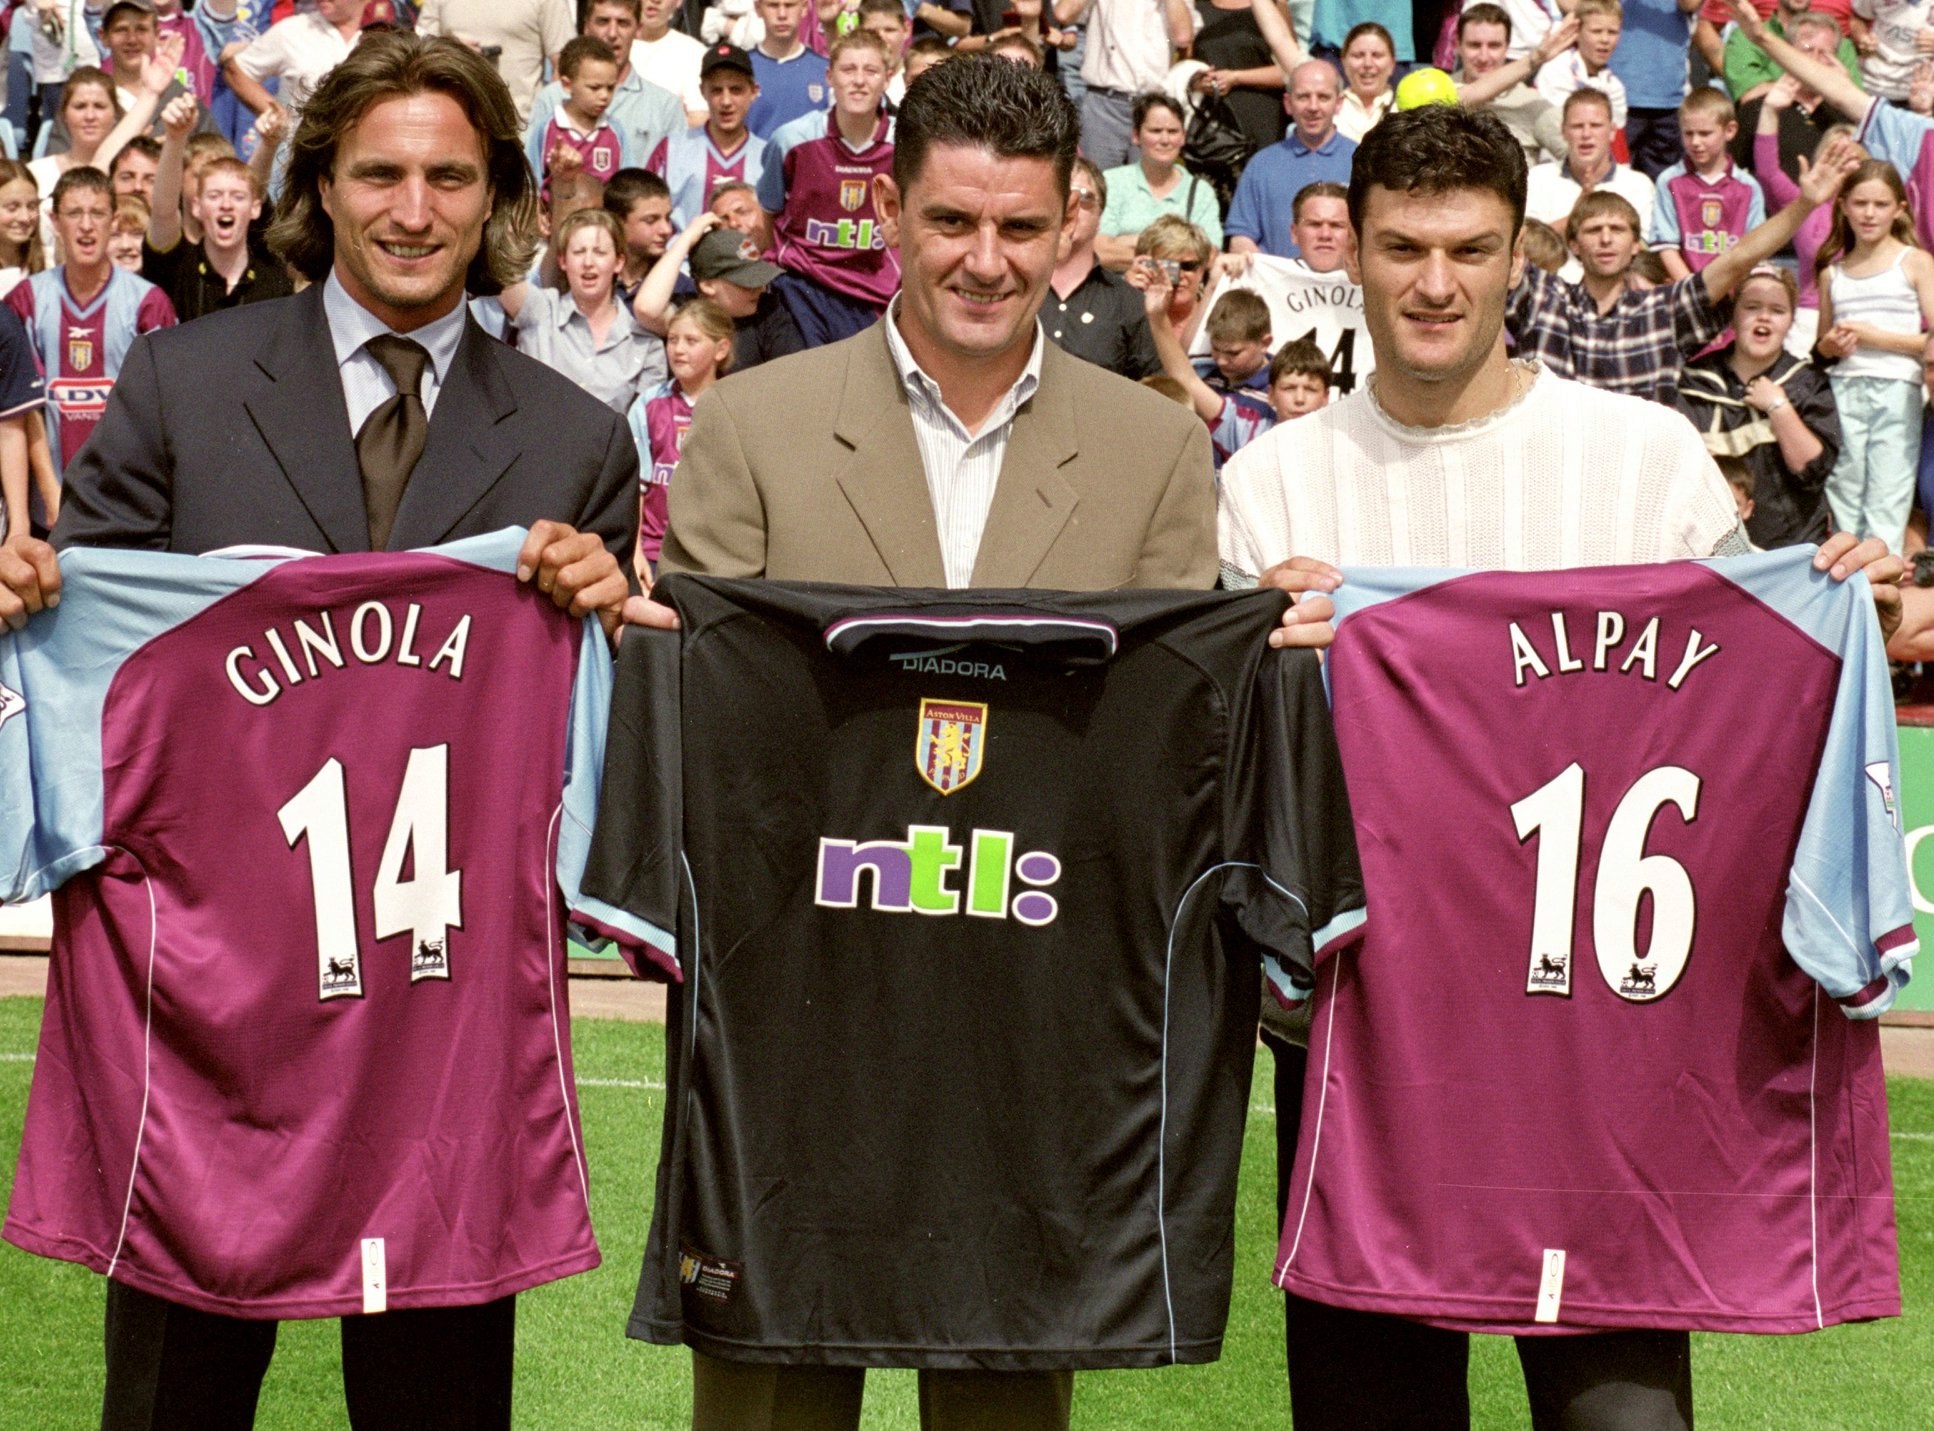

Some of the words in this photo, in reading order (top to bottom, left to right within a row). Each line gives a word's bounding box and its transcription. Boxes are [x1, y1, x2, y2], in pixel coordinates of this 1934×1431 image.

[224, 599, 475, 707] GINOLA
[902, 656, 1007, 681] DIADORA
[1508, 610, 1722, 692] ALPAY
[925, 708, 954, 720] ASTON
[955, 711, 981, 723] VILLA
[275, 742, 466, 1003] 14
[814, 824, 1062, 927] ntl:
[1508, 760, 1704, 1005] 16
